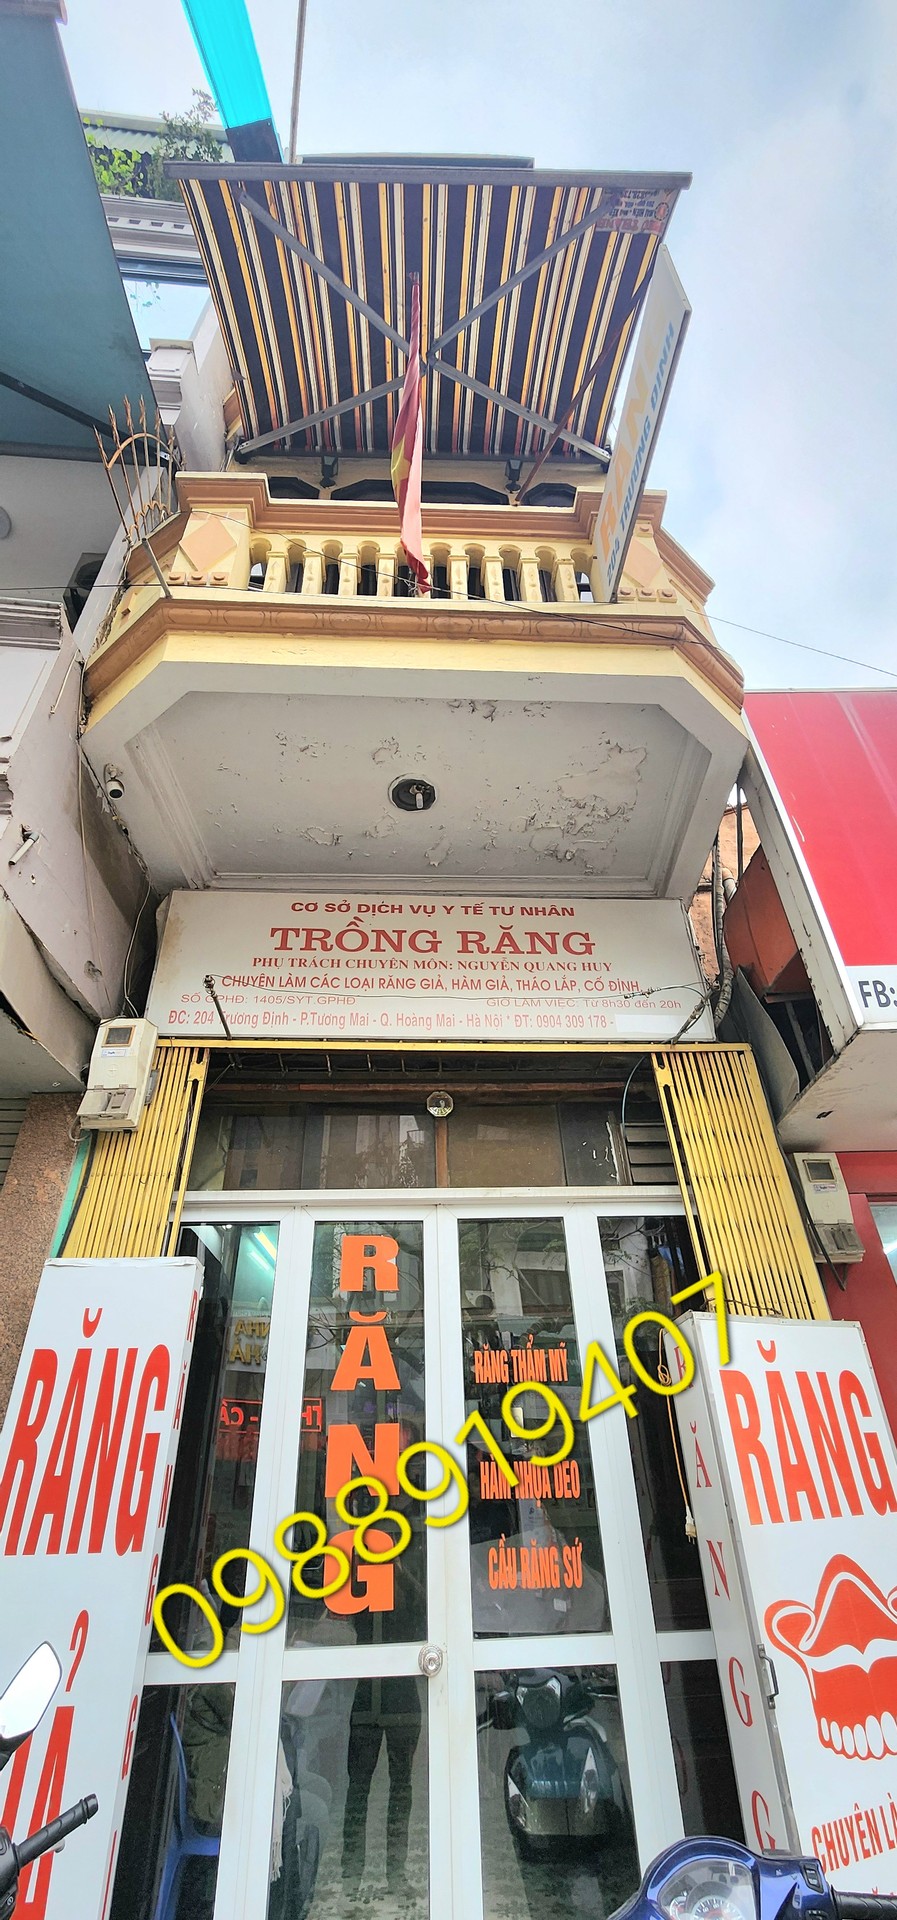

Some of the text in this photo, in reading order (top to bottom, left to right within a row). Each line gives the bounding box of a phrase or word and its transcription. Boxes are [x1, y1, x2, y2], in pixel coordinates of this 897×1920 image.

[607, 536, 620, 587] 204
[291, 902, 319, 913] CƠ
[324, 899, 351, 913] SỞ
[409, 904, 436, 917] VỤ
[442, 905, 455, 915] Y
[461, 901, 485, 915] TẾ
[489, 904, 515, 916] TƯ
[520, 904, 575, 917] NHÂN
[270, 915, 596, 956] TRỒNG RĂNG
[221, 972, 275, 987] CHUYÊN
[279, 972, 306, 988] LÀM
[310, 973, 340, 988] CÁC
[344, 977, 374, 991] LOẠI
[378, 974, 416, 989] RĂNG
[420, 973, 448, 992] GIẢ,
[451, 975, 481, 990] HÀM
[485, 974, 513, 993] GIẢ,
[516, 975, 551, 991] THÁO
[554, 974, 581, 993] LẮP,
[584, 976, 605, 992] CỐ
[252, 955, 612, 973] PHỤ TRÁCH CHUYÊN MÔN: NGUYỄN QUANG HUY
[168, 1010, 190, 1024] ĐC:
[193, 1010, 214, 1025] 204
[262, 1011, 289, 1029] Định
[300, 1011, 346, 1030] P.Tương
[350, 1012, 369, 1027] Mai
[380, 1012, 392, 1027] Q.
[396, 1012, 432, 1031] Hoàng
[436, 1013, 455, 1028] Mai
[466, 1013, 481, 1028] Hà
[485, 1013, 503, 1031] Nội
[514, 1014, 533, 1029] ĐT:
[536, 1014, 562, 1029] 0904
[565, 1014, 585, 1029] 309
[588, 1014, 607, 1029] 178
[180, 992, 201, 1004] SỐ
[602, 999, 631, 1009] 8h30
[634, 999, 656, 1009] đến
[660, 1000, 682, 1009] 20h
[474, 1333, 569, 1384] RĂNG THẨM MỸ
[0, 1307, 171, 1557] RĂNG
[322, 1234, 401, 1616] RĂNG
[719, 1339, 897, 1527] RĂNG
[146, 1290, 199, 1626] RĂNG
[488, 1532, 583, 1590] CẦU RĂNG SỨ
[811, 1802, 884, 1876] CHUYÊN
